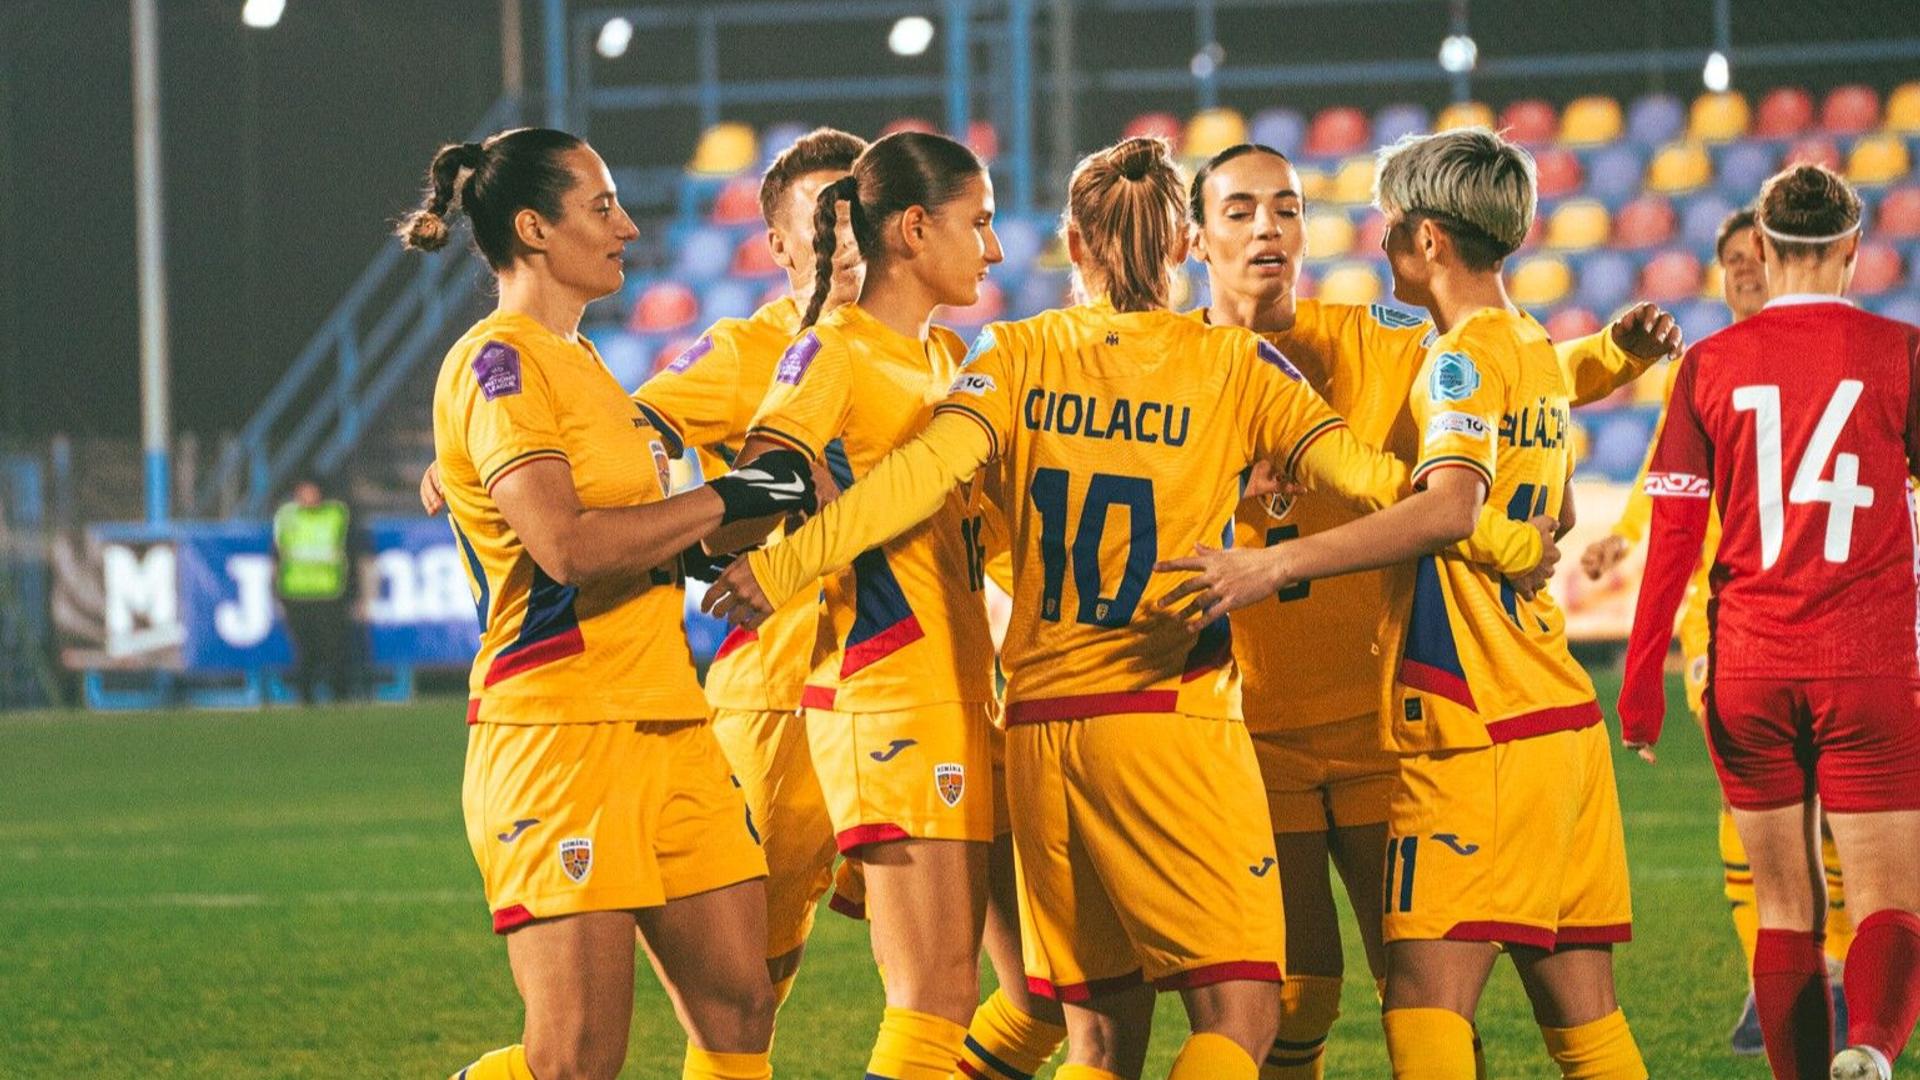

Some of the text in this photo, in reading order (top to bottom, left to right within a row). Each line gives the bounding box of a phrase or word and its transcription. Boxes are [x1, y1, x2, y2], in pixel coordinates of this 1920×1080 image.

[1024, 387, 1191, 447] CIOLACU
[1732, 379, 1875, 571] 14
[1030, 466, 1158, 628] 10
[1385, 835, 1418, 914] 11
